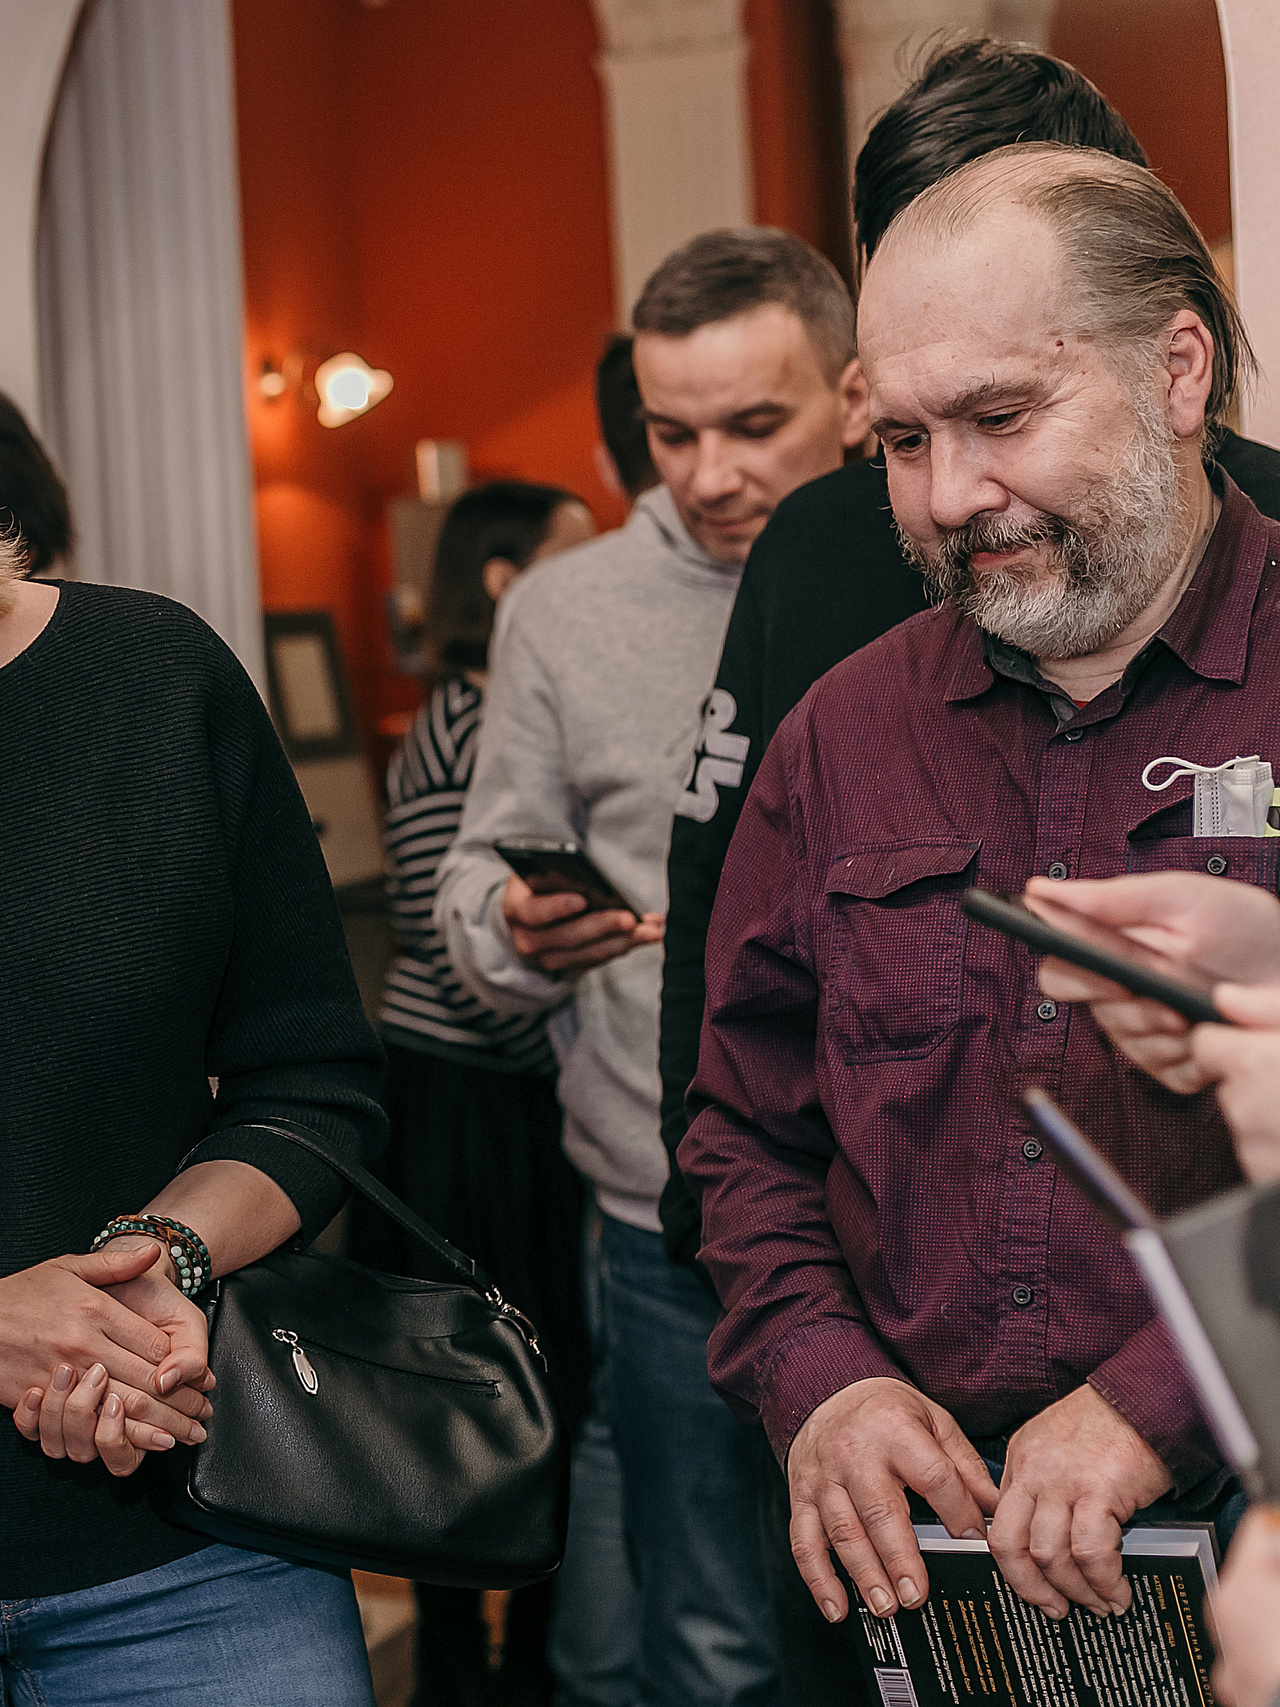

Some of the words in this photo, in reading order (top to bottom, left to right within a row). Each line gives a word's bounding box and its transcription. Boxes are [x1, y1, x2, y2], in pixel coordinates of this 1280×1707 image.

[991, 1570, 1001, 1591] онные
[1153, 1574, 1167, 1610] КАТЕРИНА
[983, 1601, 991, 1612] Где
[997, 1591, 1007, 1613] ответы
[1006, 1621, 1015, 1640] часто
[1006, 1591, 1017, 1614] личной
[1029, 1675, 1038, 1693] также
[1056, 1637, 1064, 1648] кто
[1068, 1622, 1083, 1659] исполнения
[1084, 1614, 1093, 1627] уже
[1090, 1631, 1101, 1655] первые
[1098, 1628, 1108, 1647] автор
[1175, 1575, 1203, 1660] СОВРЕМЕННАЯ
[1199, 1668, 1214, 1705] БИОГР
[931, 1650, 940, 1667] книге
[945, 1611, 957, 1642] построить
[954, 1642, 968, 1677] счастливый
[963, 1677, 974, 1695] брак?
[957, 1599, 972, 1635] добиваться
[979, 1676, 990, 1695] цели?
[971, 1612, 984, 1643] научиться
[979, 1643, 989, 1663] всегда
[988, 1677, 997, 1693] всем
[1010, 1640, 1025, 1677] задаваемые
[1018, 1602, 1029, 1622] самой
[1024, 1622, 1037, 1655] Катериной
[1032, 1654, 1044, 1679] Шпицей
[1039, 1679, 1047, 1690] без
[1059, 1649, 1068, 1666] хочет
[1083, 1641, 1091, 1655] мир
[931, 1617, 939, 1632] этом
[936, 1637, 947, 1660] многом
[942, 1659, 953, 1681] другом
[949, 1681, 960, 1705] читайте
[1124, 1652, 1135, 1678] Золотая
[1163, 1658, 1176, 1689] фильмам
[1047, 1673, 1057, 1695] Только
[1064, 1667, 1072, 1684] быть
